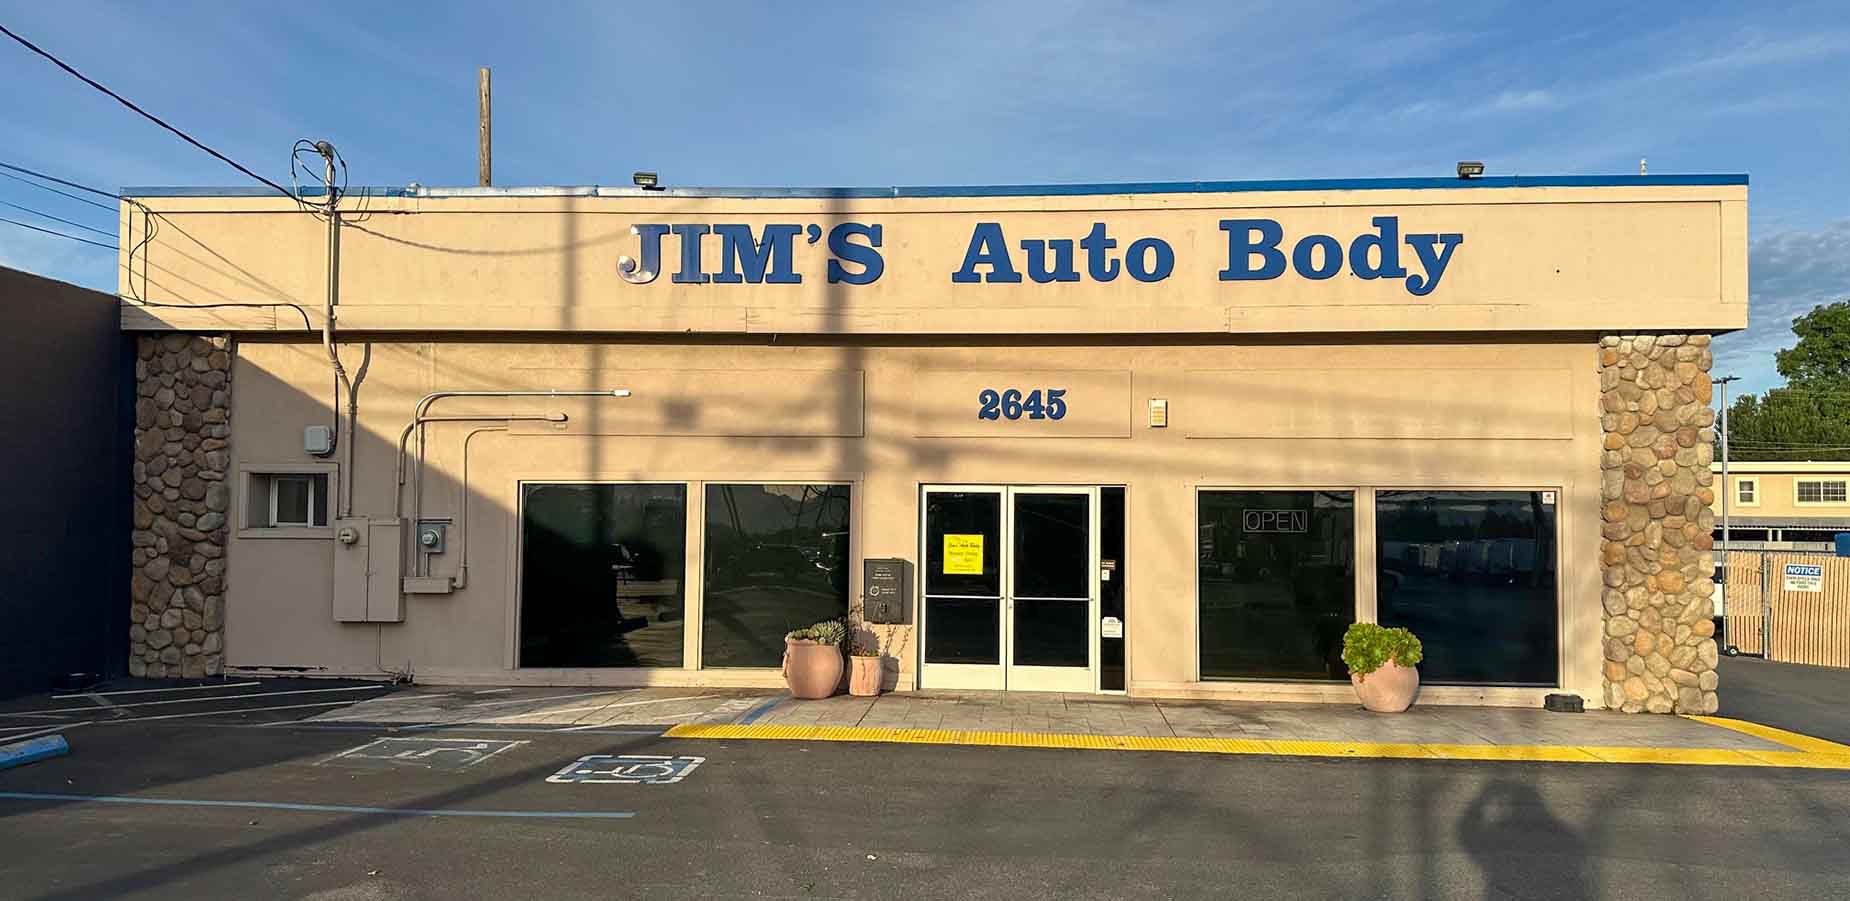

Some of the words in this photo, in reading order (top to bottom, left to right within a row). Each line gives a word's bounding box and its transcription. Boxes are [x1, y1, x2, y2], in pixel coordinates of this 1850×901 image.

[617, 223, 885, 285] JIM'S
[953, 222, 1175, 283] Auto
[1219, 216, 1463, 296] Body
[978, 389, 1067, 420] 2645
[1246, 511, 1305, 530] OPEN
[1787, 566, 1819, 575] NOTICE
